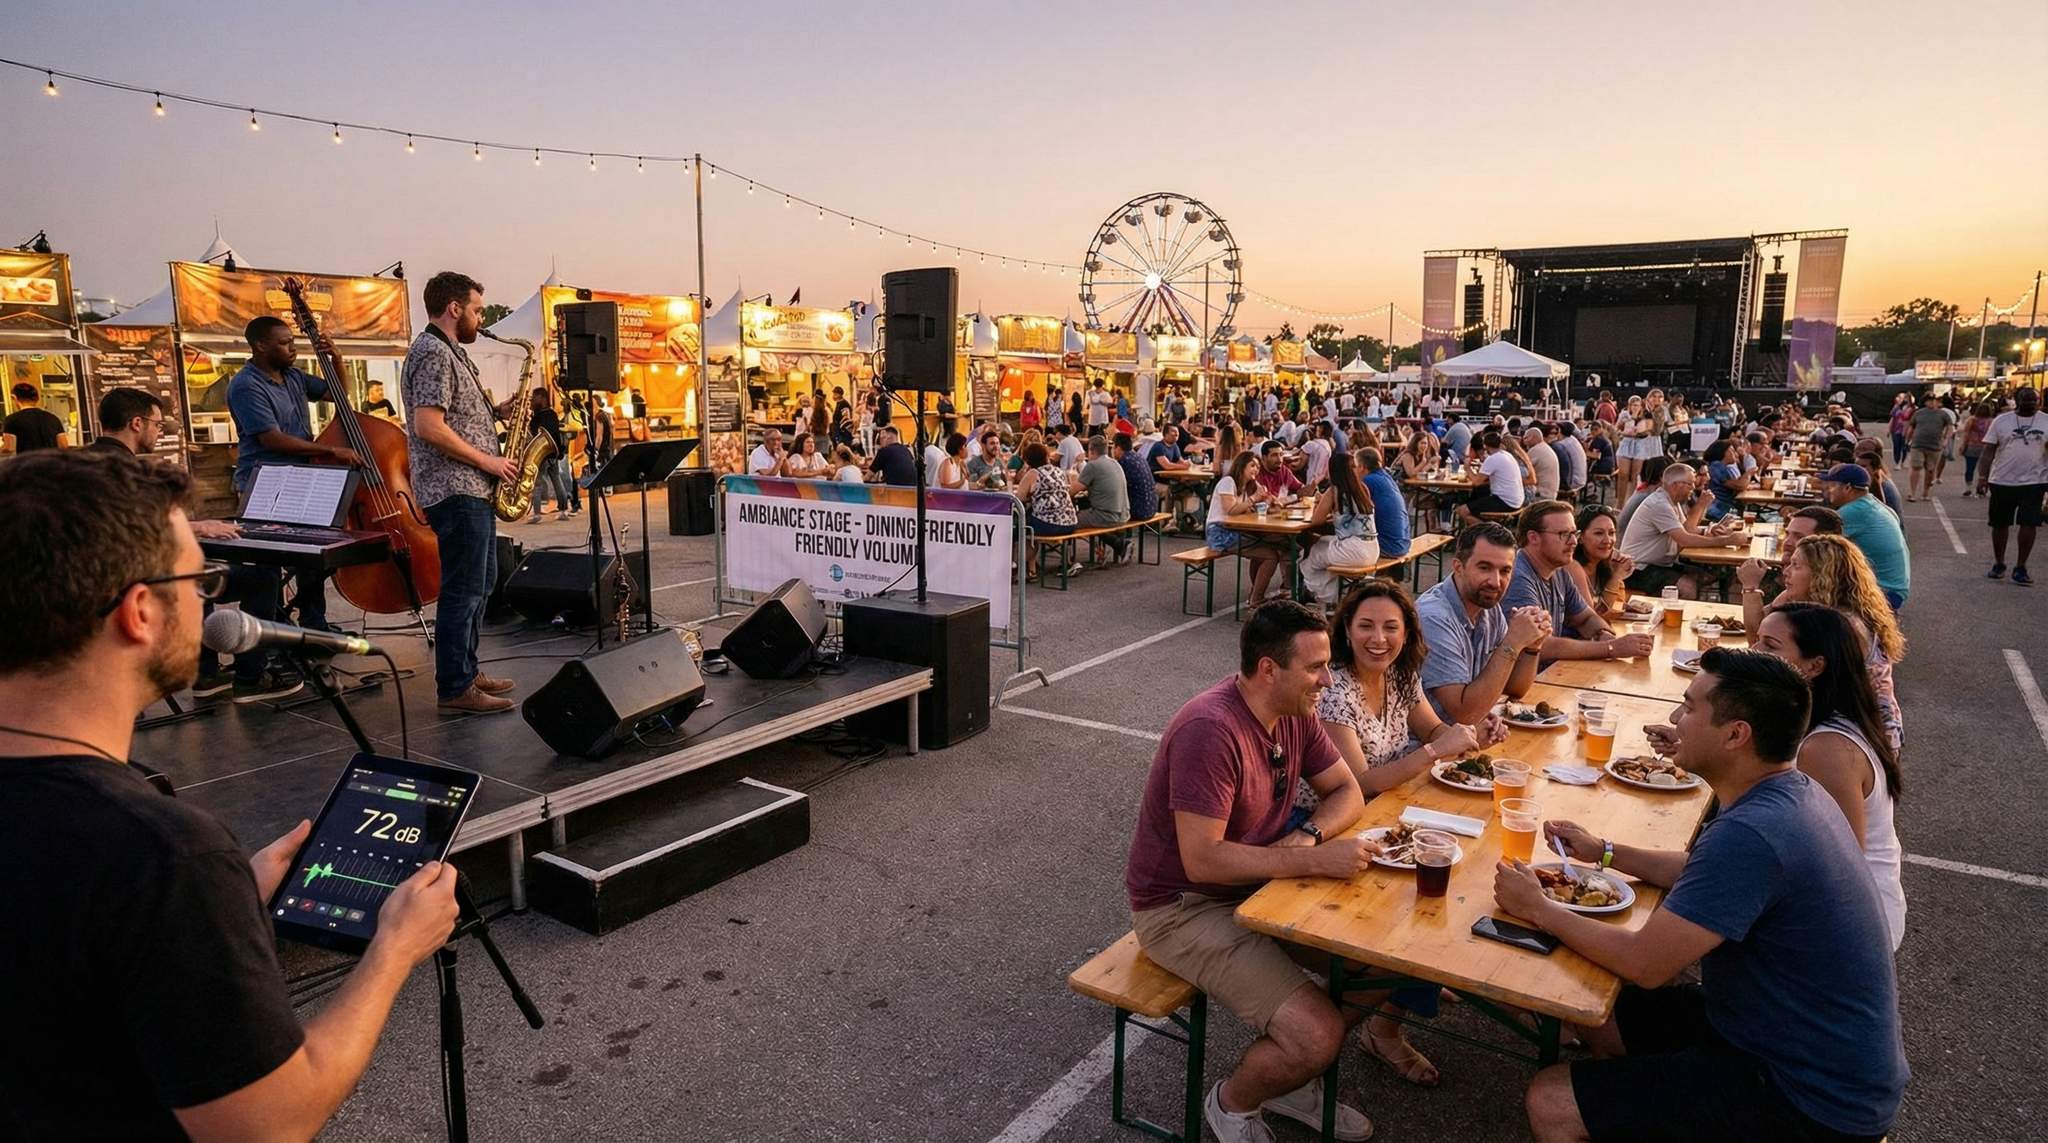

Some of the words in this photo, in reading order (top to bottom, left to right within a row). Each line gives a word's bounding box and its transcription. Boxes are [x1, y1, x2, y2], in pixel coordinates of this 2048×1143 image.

[739, 502, 805, 529] AMBIANCE
[809, 509, 851, 534] STAGE
[866, 514, 916, 540] DINING
[795, 532, 859, 559] FRIENDLY
[354, 808, 398, 840] 72
[394, 827, 421, 844] dB
